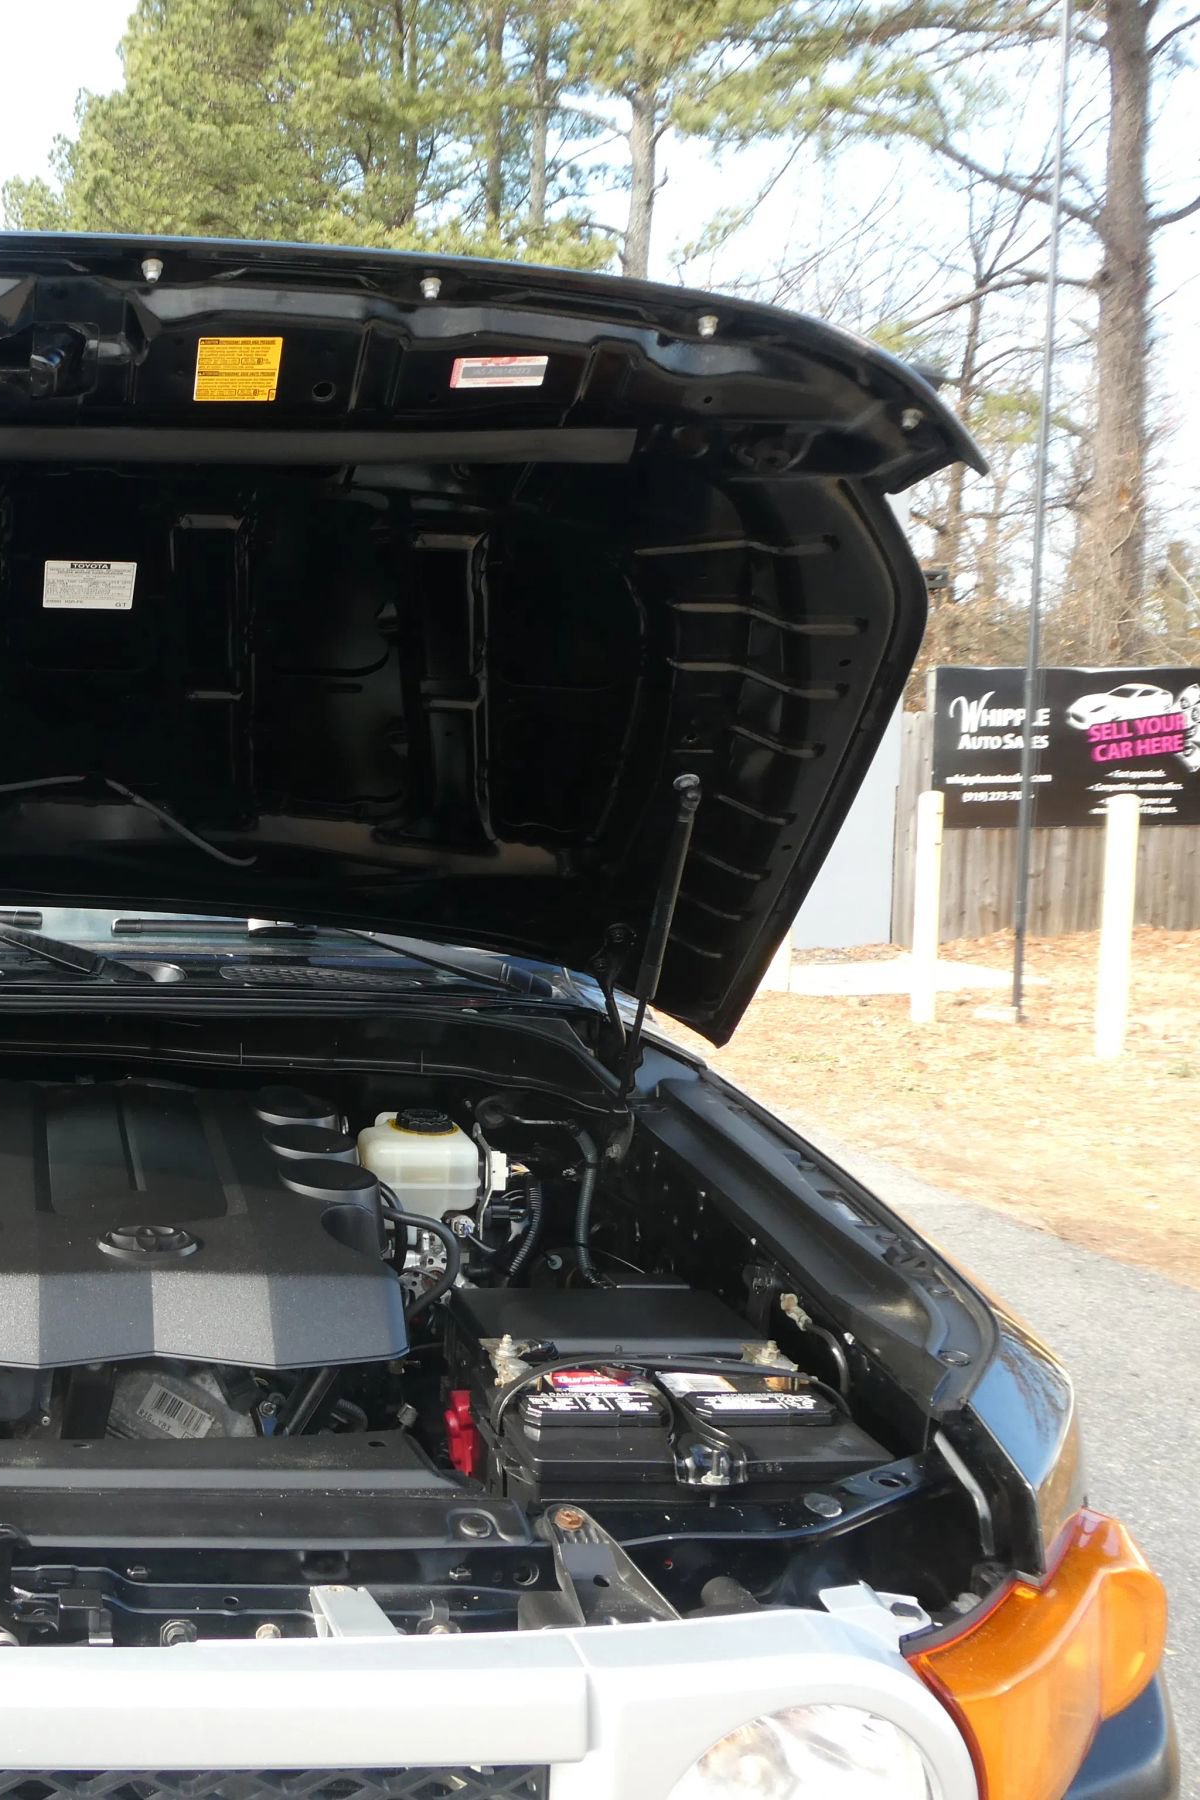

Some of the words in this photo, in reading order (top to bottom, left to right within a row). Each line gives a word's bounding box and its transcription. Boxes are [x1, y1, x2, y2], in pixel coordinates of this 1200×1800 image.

[949, 691, 1050, 733] WHIPPE
[958, 734, 1002, 750] AUTO
[1002, 733, 1049, 749] SAES
[1088, 722, 1132, 742] SELL
[1135, 714, 1187, 735] YOUR
[1094, 743, 1135, 762] CAR
[1136, 734, 1184, 756] HERE
